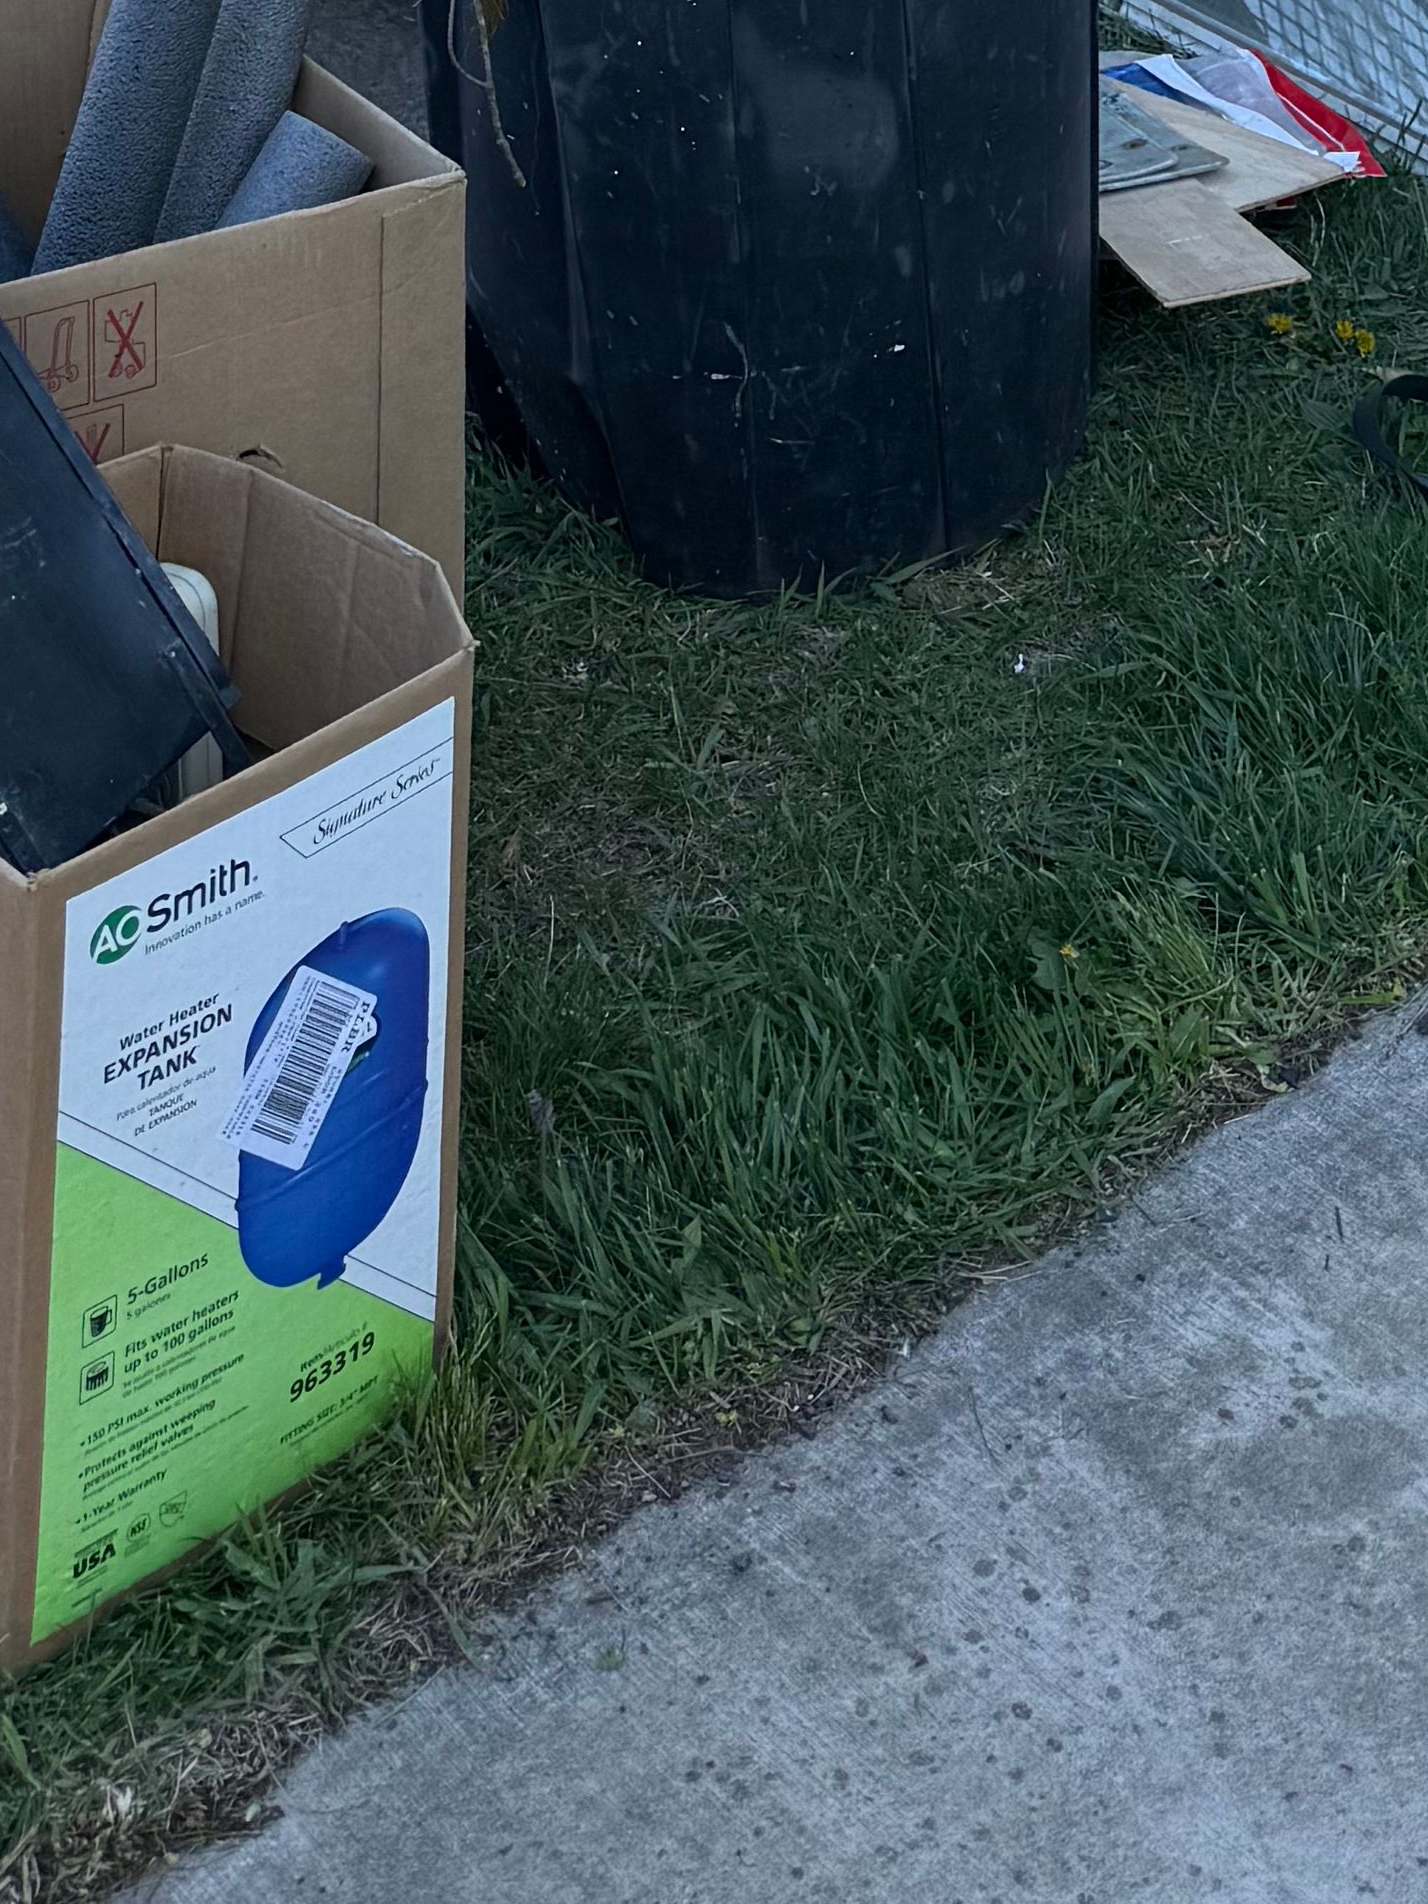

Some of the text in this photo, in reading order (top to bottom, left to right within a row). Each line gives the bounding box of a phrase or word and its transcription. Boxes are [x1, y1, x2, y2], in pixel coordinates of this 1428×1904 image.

[313, 757, 441, 846] Signature Series
[92, 908, 142, 964] AO
[145, 921, 202, 955] Innovation
[204, 910, 224, 927] has
[103, 1003, 234, 1085] EXPANSION
[119, 992, 220, 1052] Water Heater
[340, 1000, 371, 1054] PLBR
[136, 1046, 198, 1091] TANK
[133, 1125, 147, 1138] DE
[148, 1093, 187, 1117] TANQUE
[126, 1252, 209, 1306] 5-Gallons
[123, 1308, 235, 1374] up to 100 gallons
[124, 1290, 240, 1358] Fits water heaters
[289, 1331, 376, 1403] 963319
[86, 1428, 106, 1446] 150
[106, 1417, 125, 1437] PSI
[154, 1378, 199, 1408] working
[200, 1352, 246, 1386] pressure
[128, 1424, 169, 1453] against
[170, 1399, 217, 1431] weeping
[83, 1423, 194, 1492] pressure relief valves
[280, 1417, 315, 1445] FITTING
[117, 1468, 168, 1502] Warranty
[72, 1542, 117, 1579] USA
